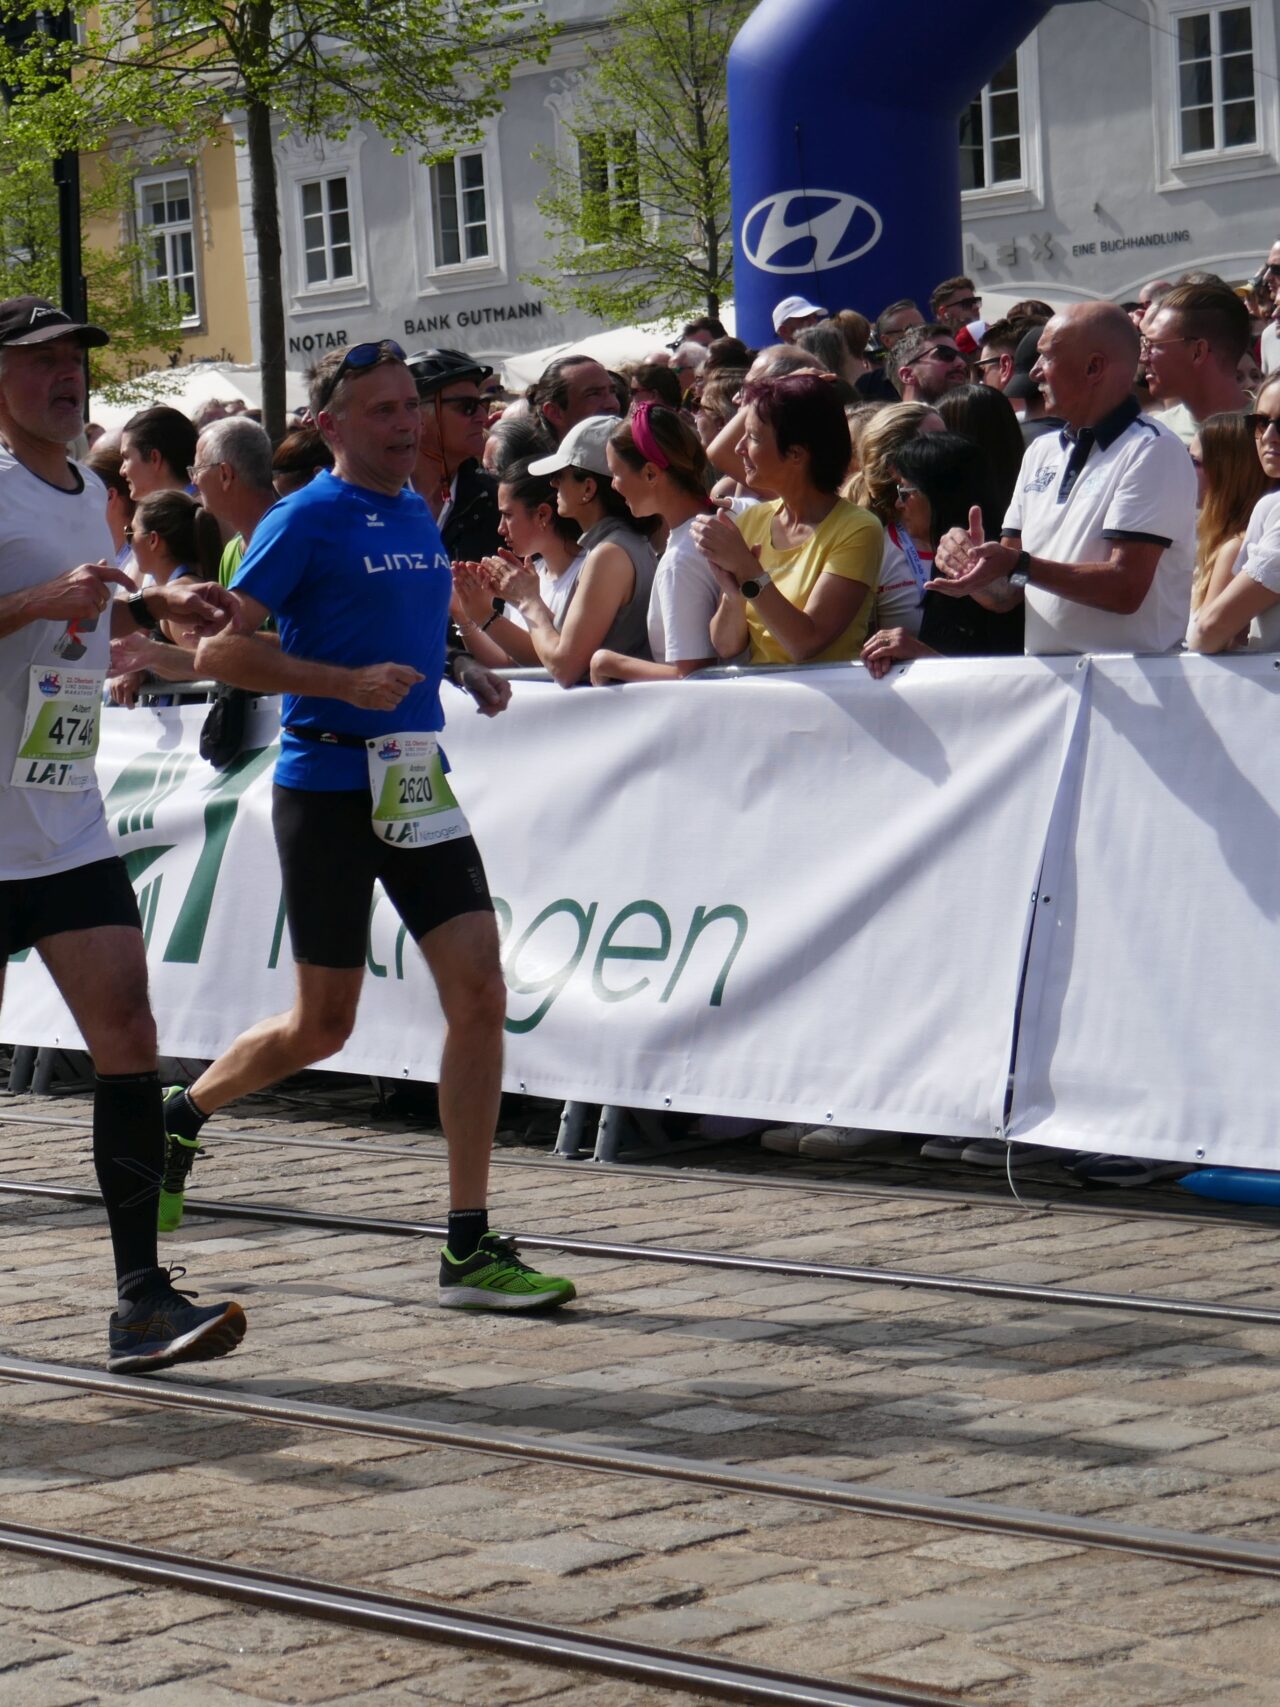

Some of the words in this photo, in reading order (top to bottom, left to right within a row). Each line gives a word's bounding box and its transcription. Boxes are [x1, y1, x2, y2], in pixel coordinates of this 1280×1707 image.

[1072, 244, 1097, 257] EINE
[1100, 230, 1190, 253] BUCHHANDLUNG
[404, 313, 451, 335] BANK
[457, 301, 543, 328] GUTMANN
[289, 330, 348, 353] NOTAR
[363, 553, 429, 574] LINZ
[25, 761, 72, 786] LAT
[399, 776, 433, 804] 2620
